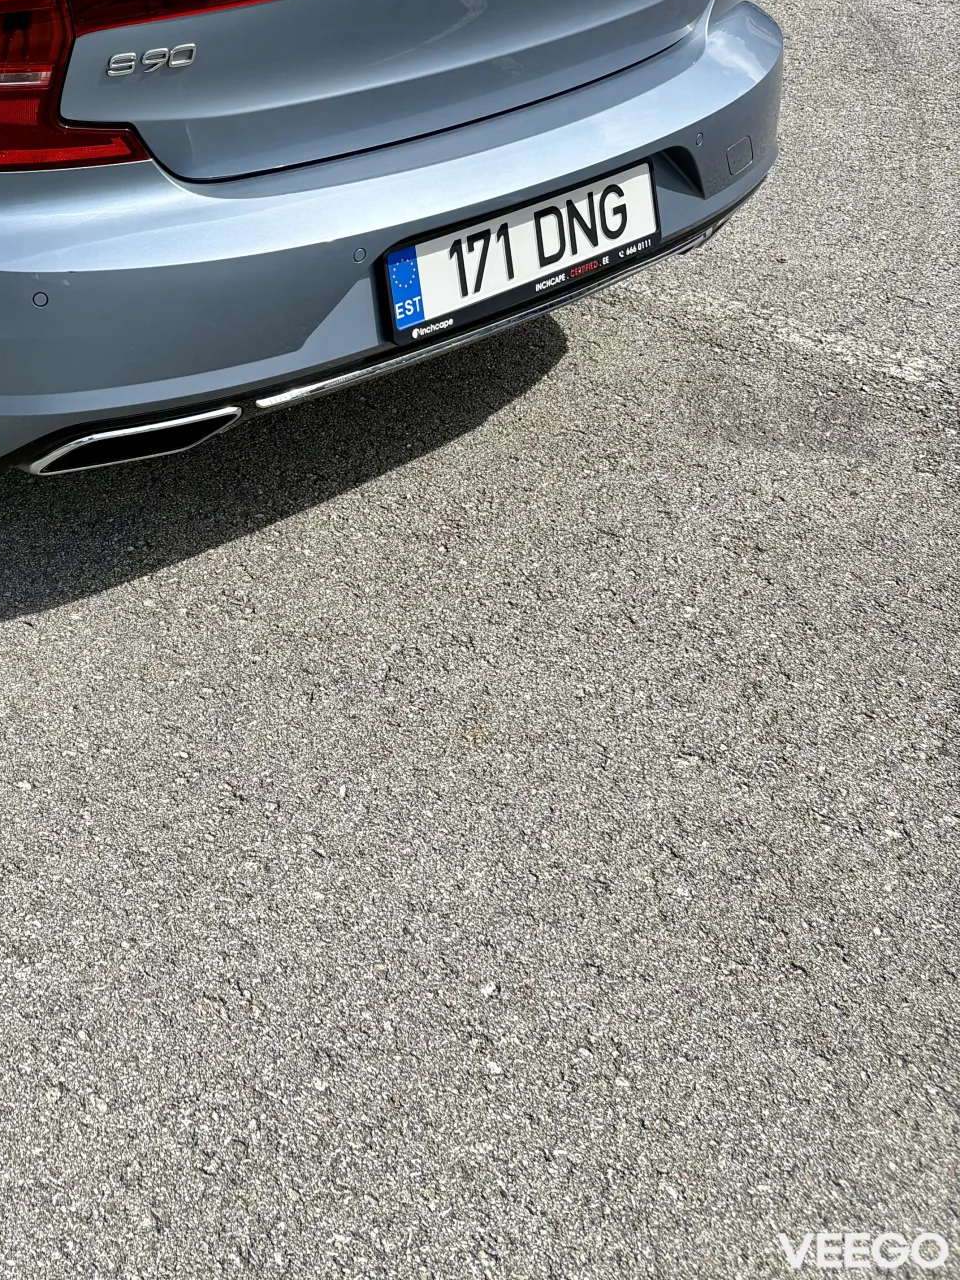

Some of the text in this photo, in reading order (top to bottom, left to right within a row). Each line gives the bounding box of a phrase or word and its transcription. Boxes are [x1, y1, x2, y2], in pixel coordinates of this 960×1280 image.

[107, 43, 197, 77] S90
[449, 184, 628, 298] 171 DNG
[570, 261, 598, 278] CERTIFIED
[626, 246, 637, 256] 666
[637, 239, 651, 251] 0111
[395, 296, 422, 320] EST
[420, 318, 454, 336] inchcape
